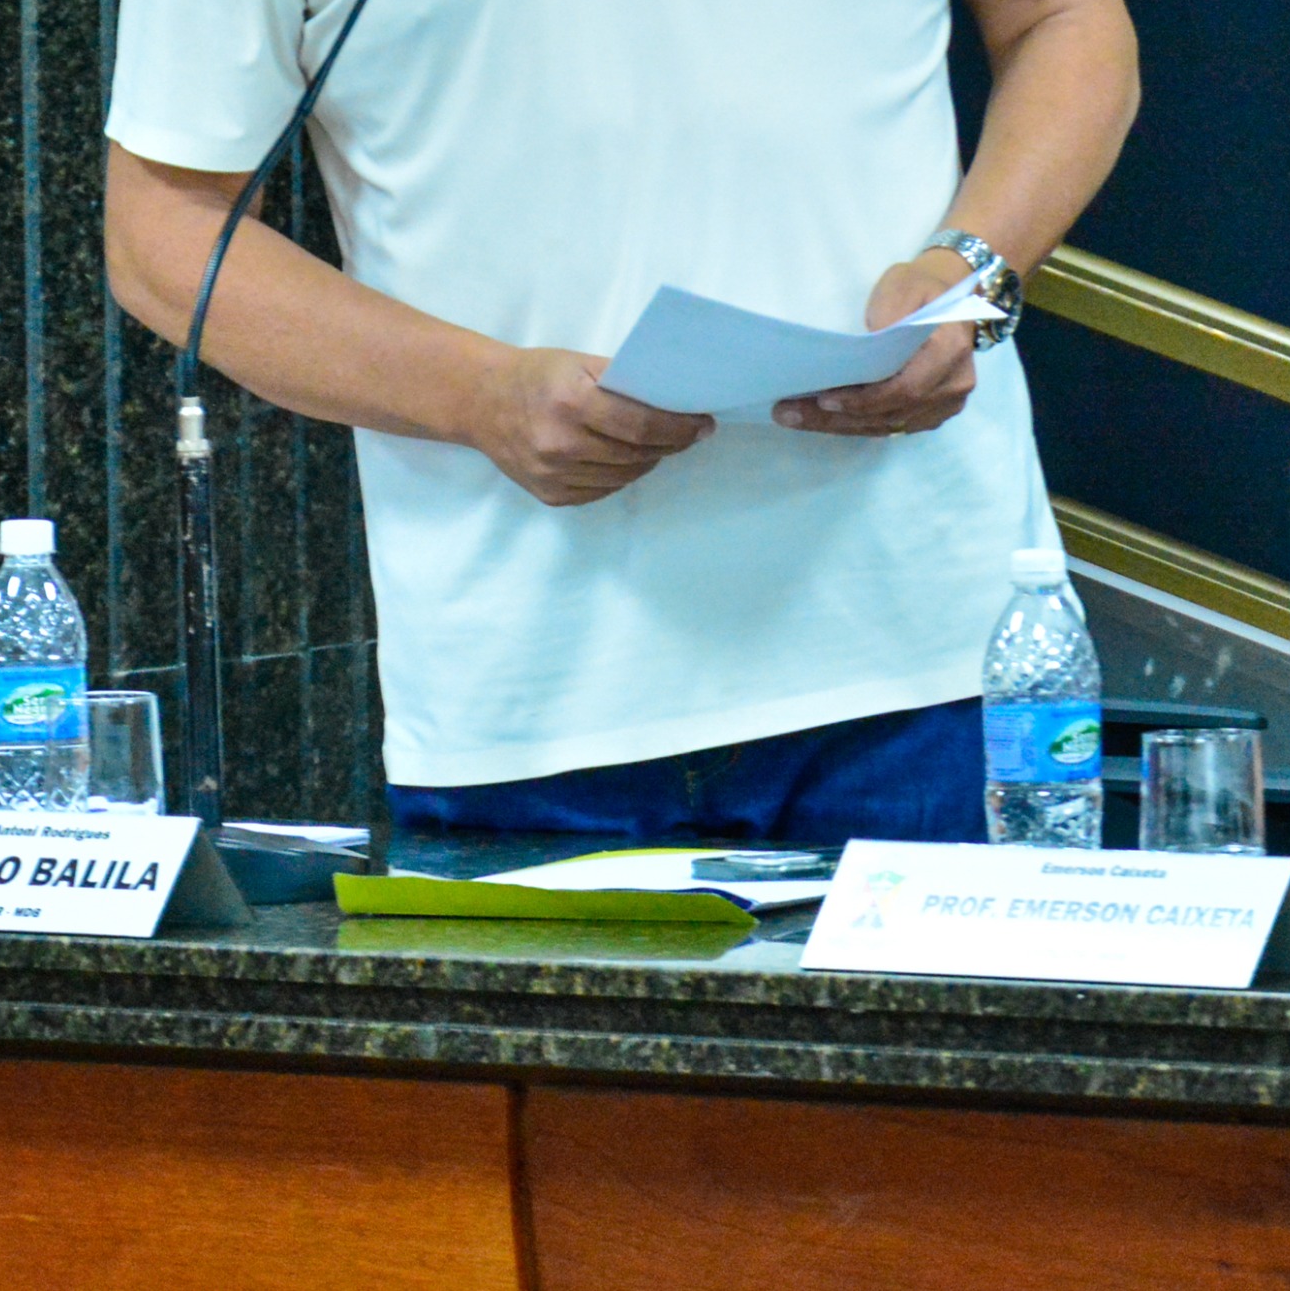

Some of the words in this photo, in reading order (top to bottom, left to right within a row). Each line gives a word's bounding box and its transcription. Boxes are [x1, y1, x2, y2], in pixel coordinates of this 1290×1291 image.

[41, 826, 110, 841] Rodrigues
[28, 857, 159, 891] BALILA
[1040, 862, 1106, 877] Emerson
[1109, 865, 1167, 879] Caixeta
[14, 907, 41, 918] MDB
[921, 894, 997, 917] PROF.
[1006, 898, 1141, 924] EMERSON
[1145, 904, 1256, 929] CAIXETA
